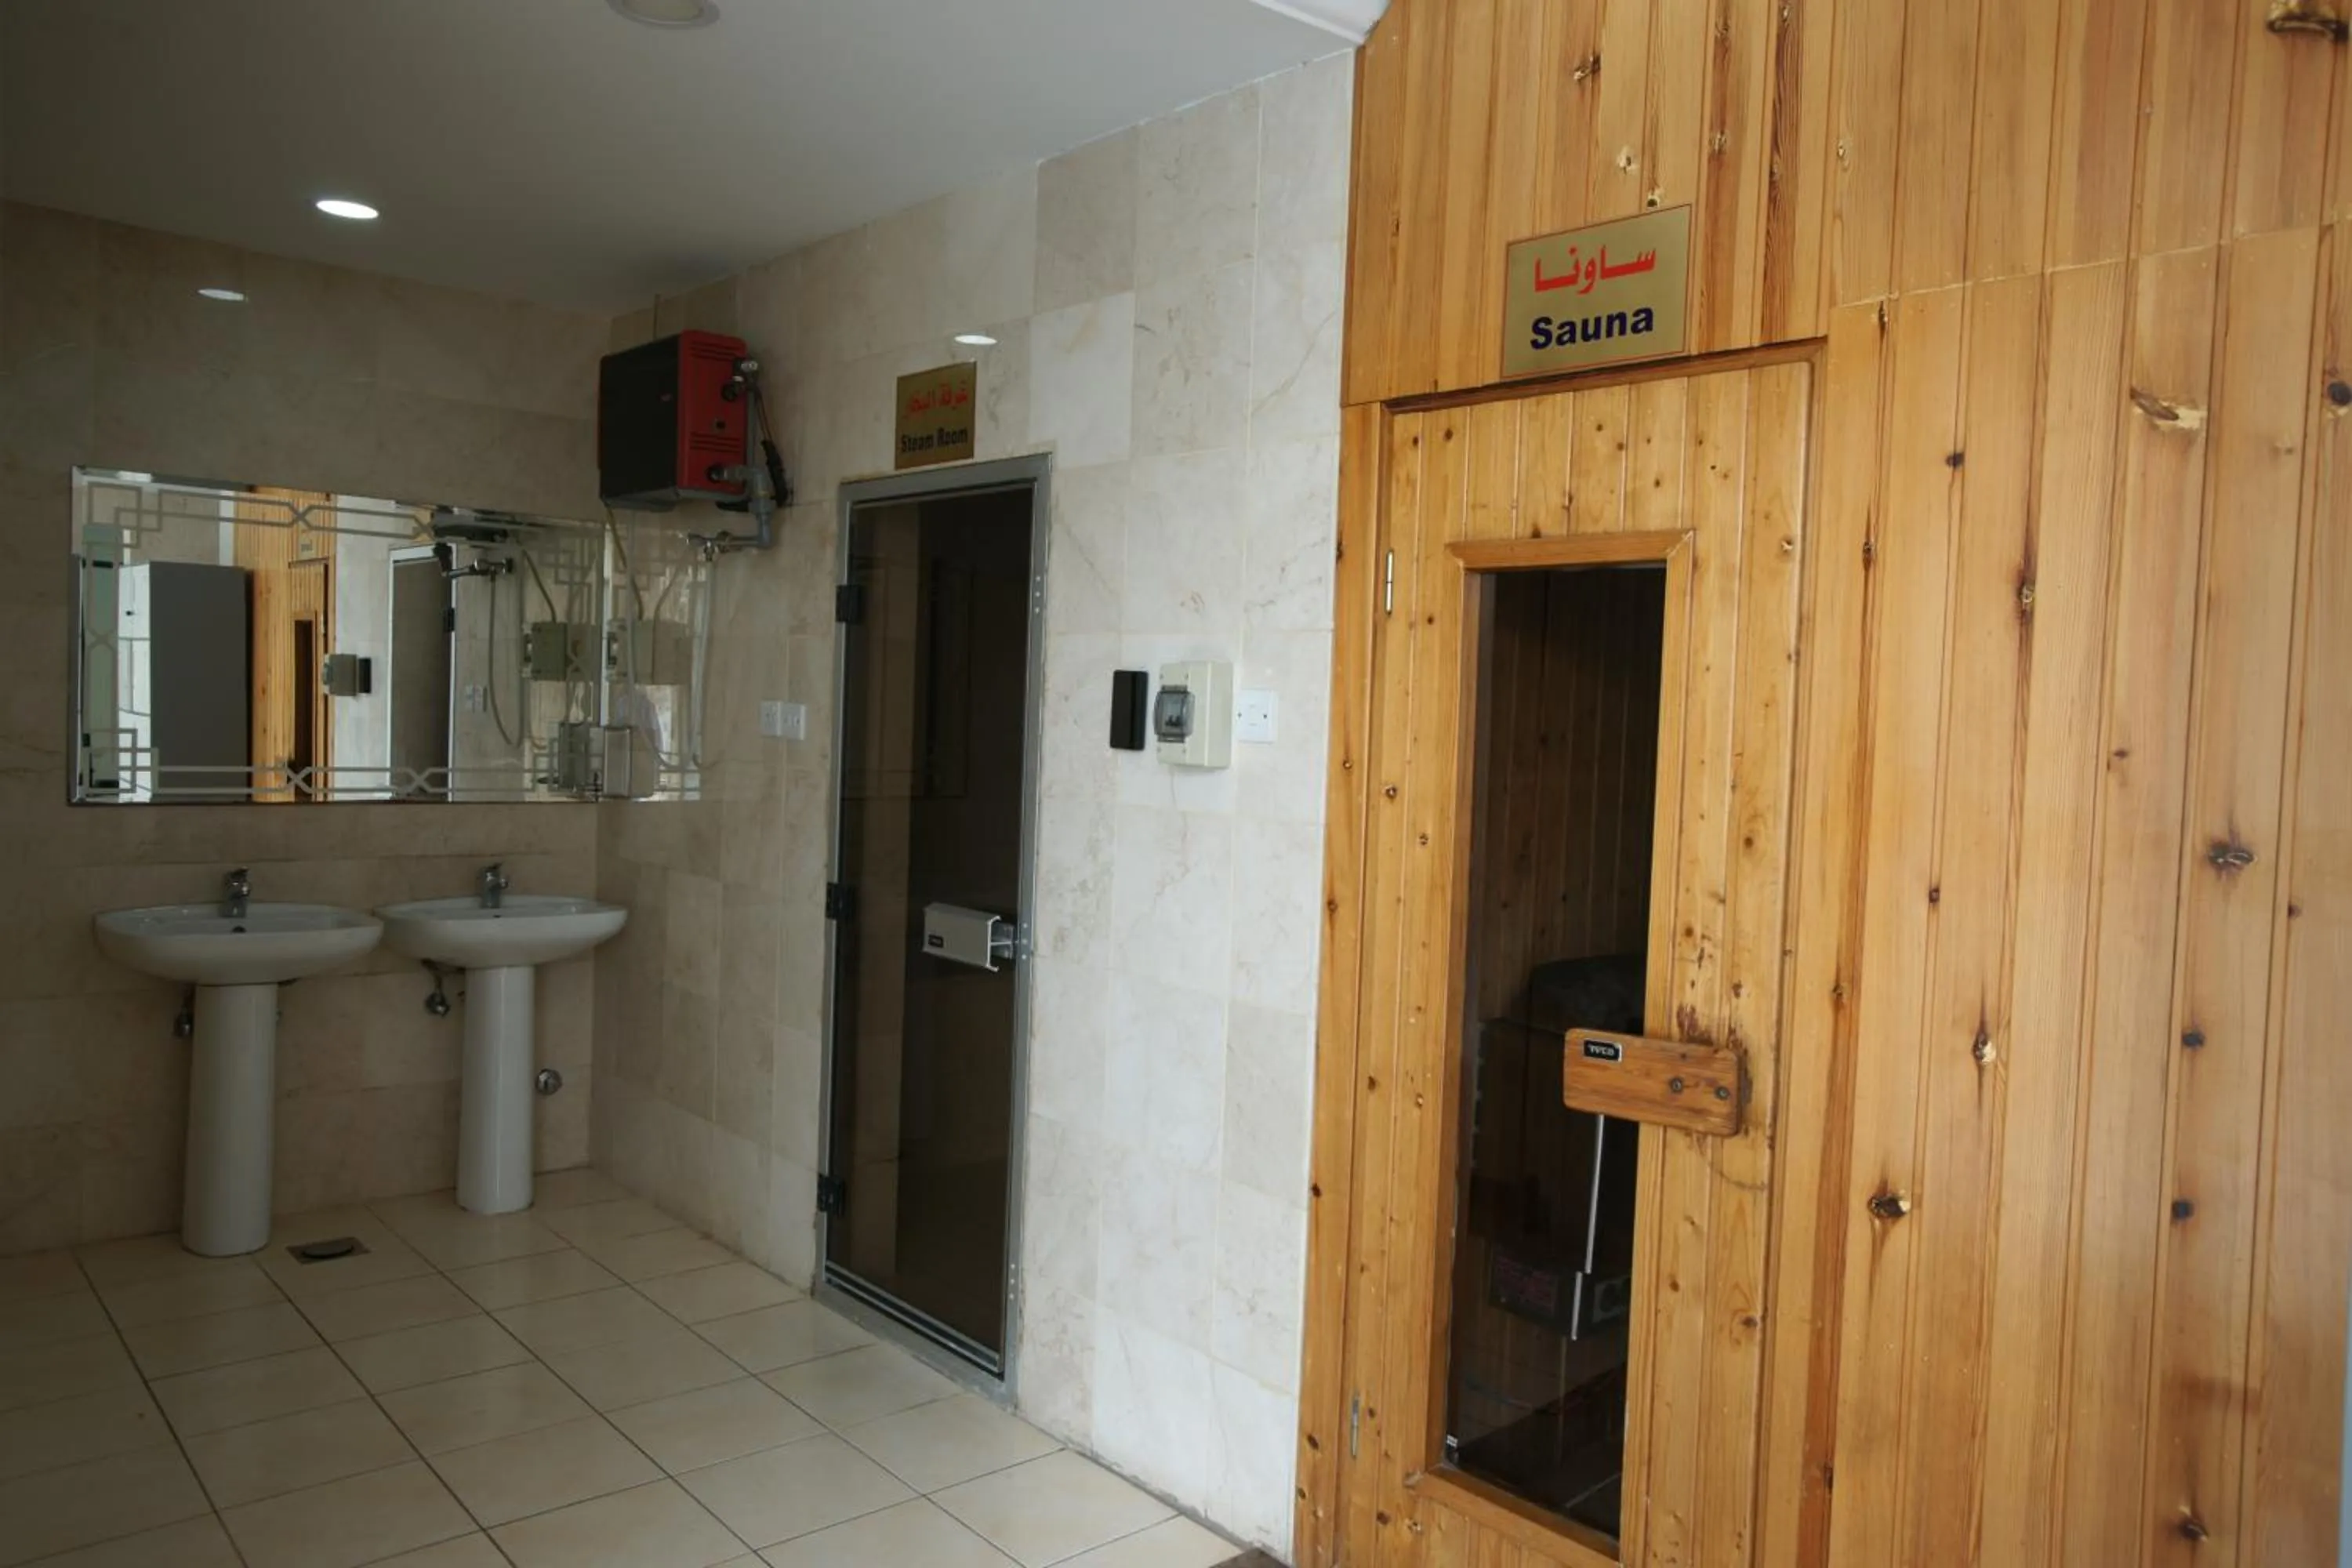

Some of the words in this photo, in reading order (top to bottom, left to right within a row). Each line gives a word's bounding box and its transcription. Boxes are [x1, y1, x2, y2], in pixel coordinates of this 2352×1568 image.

[1534, 245, 1657, 296] ساونا
[1530, 307, 1654, 350] Sauna
[900, 434, 935, 453] Steam
[937, 426, 968, 448] Room
